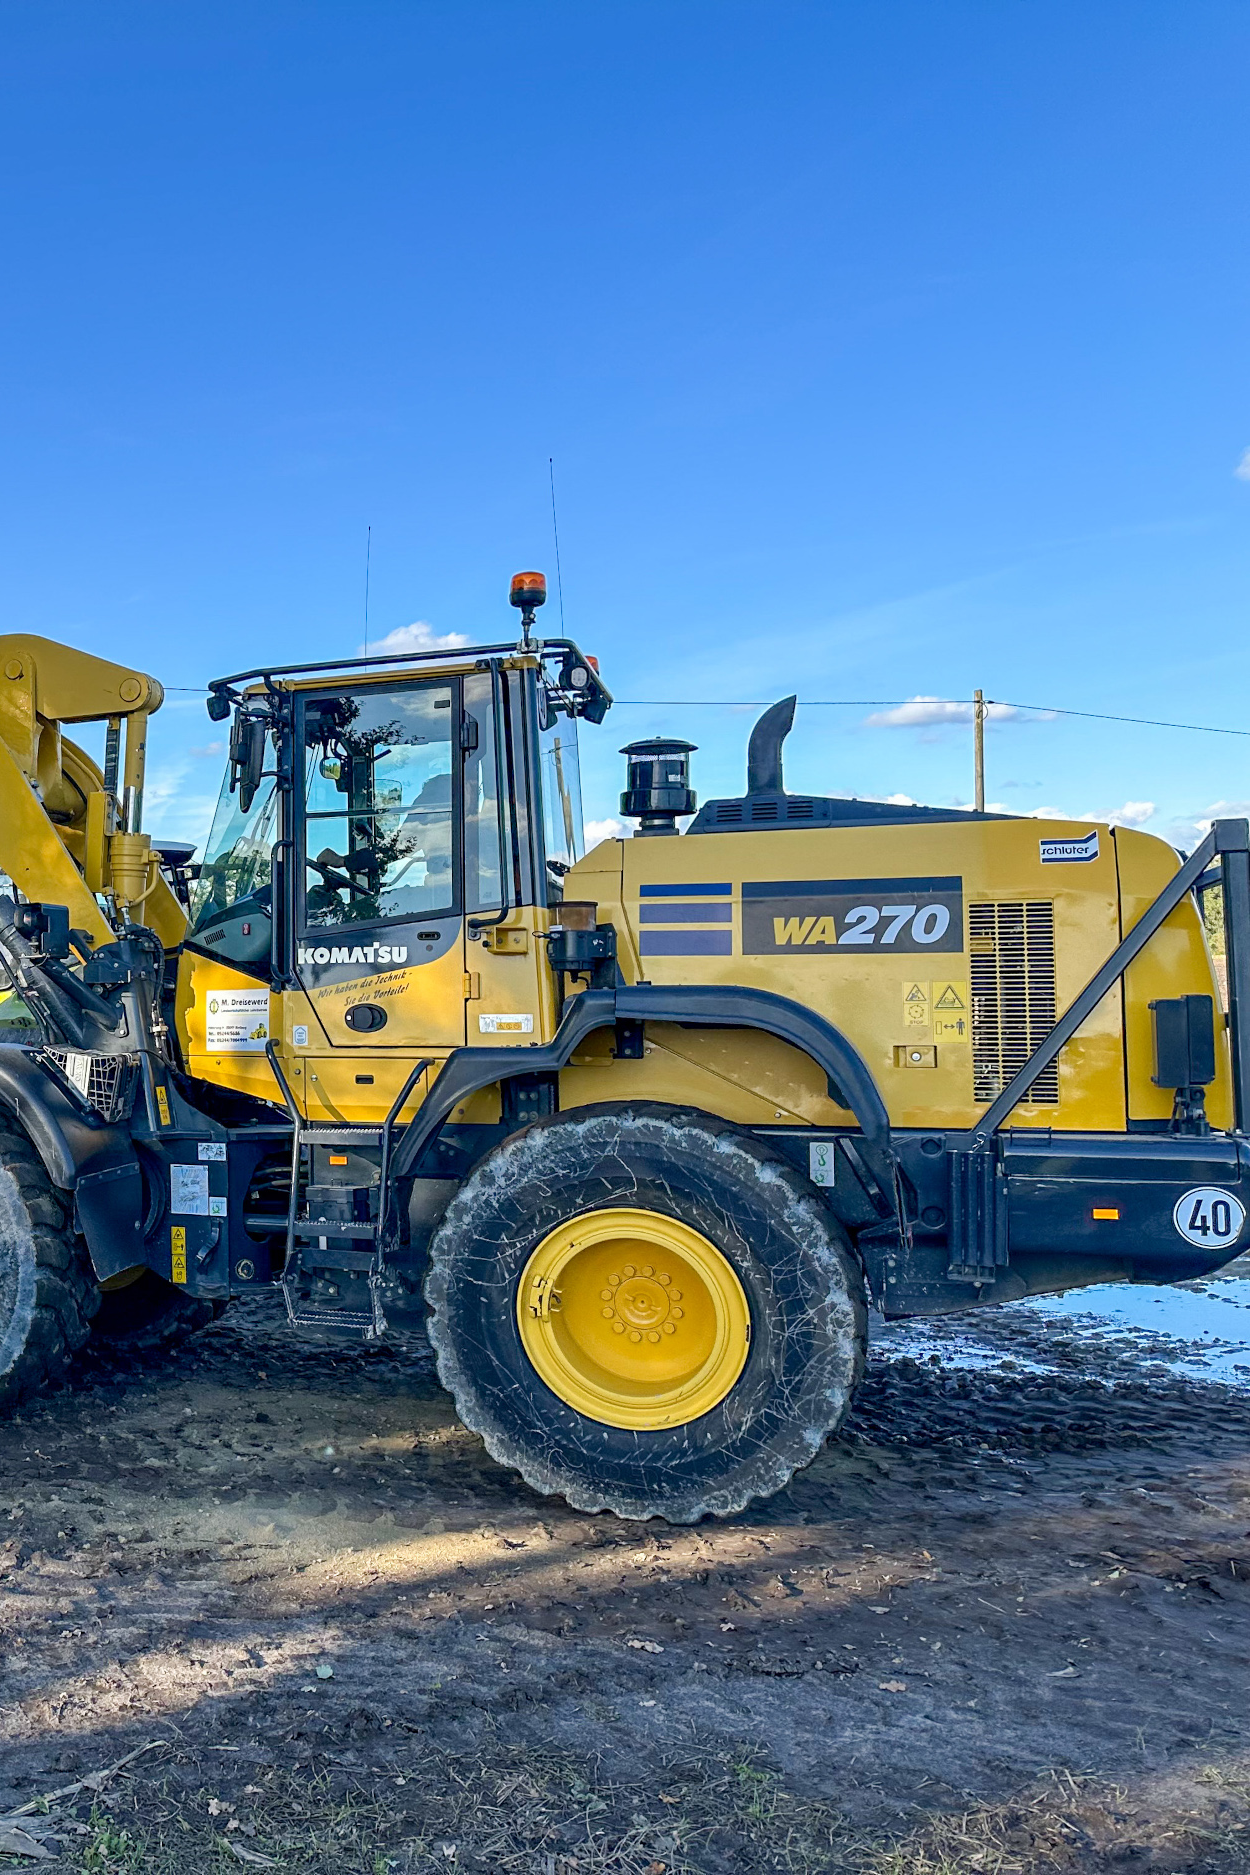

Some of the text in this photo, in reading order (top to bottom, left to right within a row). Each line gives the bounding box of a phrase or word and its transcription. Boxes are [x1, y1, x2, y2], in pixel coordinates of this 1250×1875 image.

[297, 941, 408, 965] KOMATSU
[317, 989, 332, 999] Wir
[334, 983, 358, 995] haben
[360, 978, 372, 988] die
[374, 970, 407, 985] Technik
[343, 983, 409, 1006] Sie die Vorteile!
[231, 998, 268, 1006] Dreisewerd
[1188, 1199, 1231, 1237] 40
